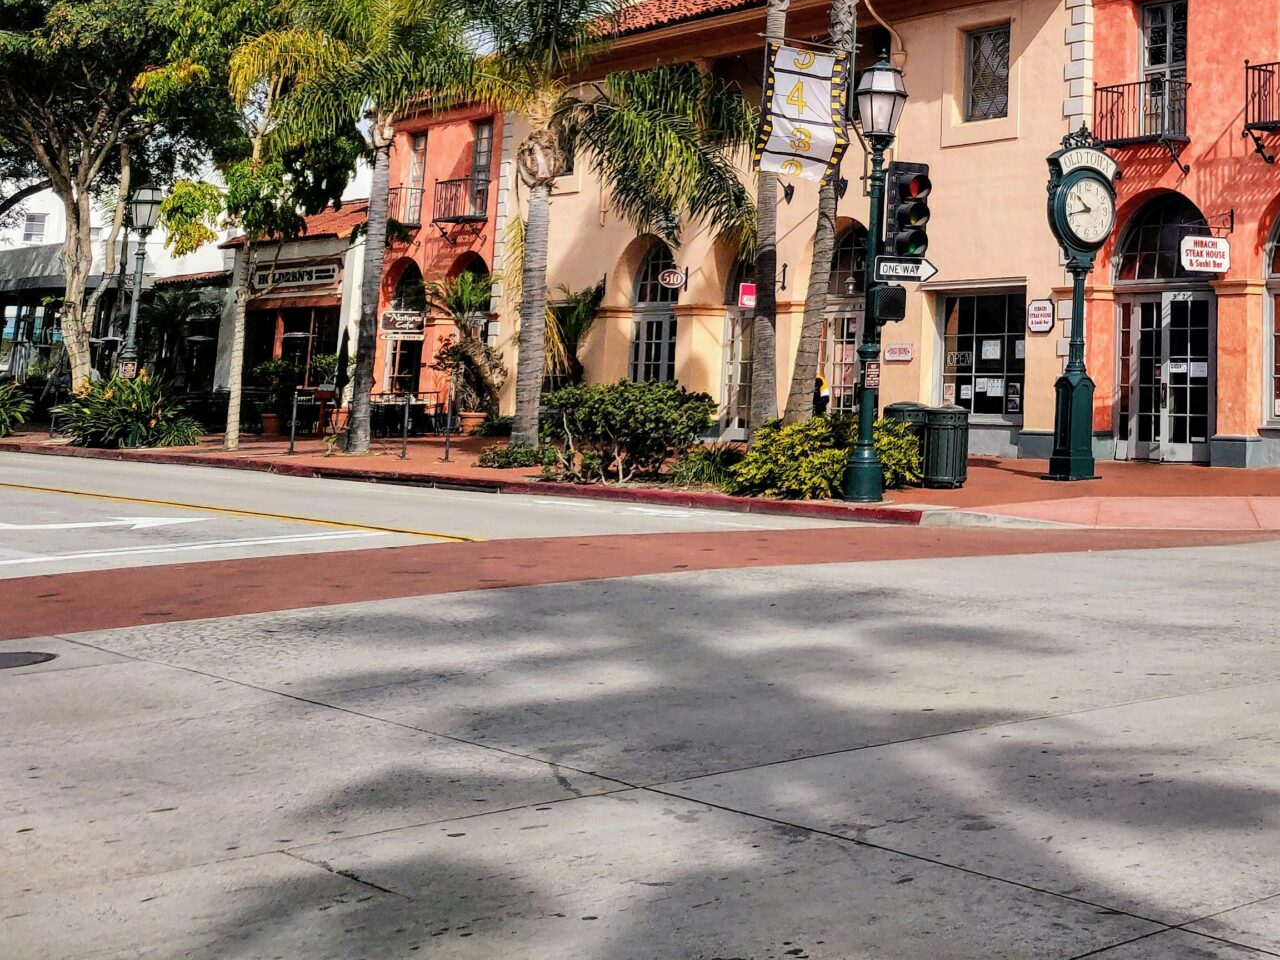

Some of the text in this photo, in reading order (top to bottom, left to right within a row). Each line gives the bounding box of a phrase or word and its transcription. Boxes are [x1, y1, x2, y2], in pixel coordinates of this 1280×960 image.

[786, 79, 807, 114] 4
[790, 127, 812, 152] 3
[1064, 152, 1112, 173] OLD TOWN
[1193, 240, 1218, 249] HIBACHI
[1185, 249, 1226, 259] STEAK HOUSE
[882, 264, 920, 274] ONE WAY
[1195, 259, 1211, 268] Sushi
[1213, 260, 1223, 268] Bar
[663, 273, 681, 284] 510
[948, 352, 971, 365] OPEN
